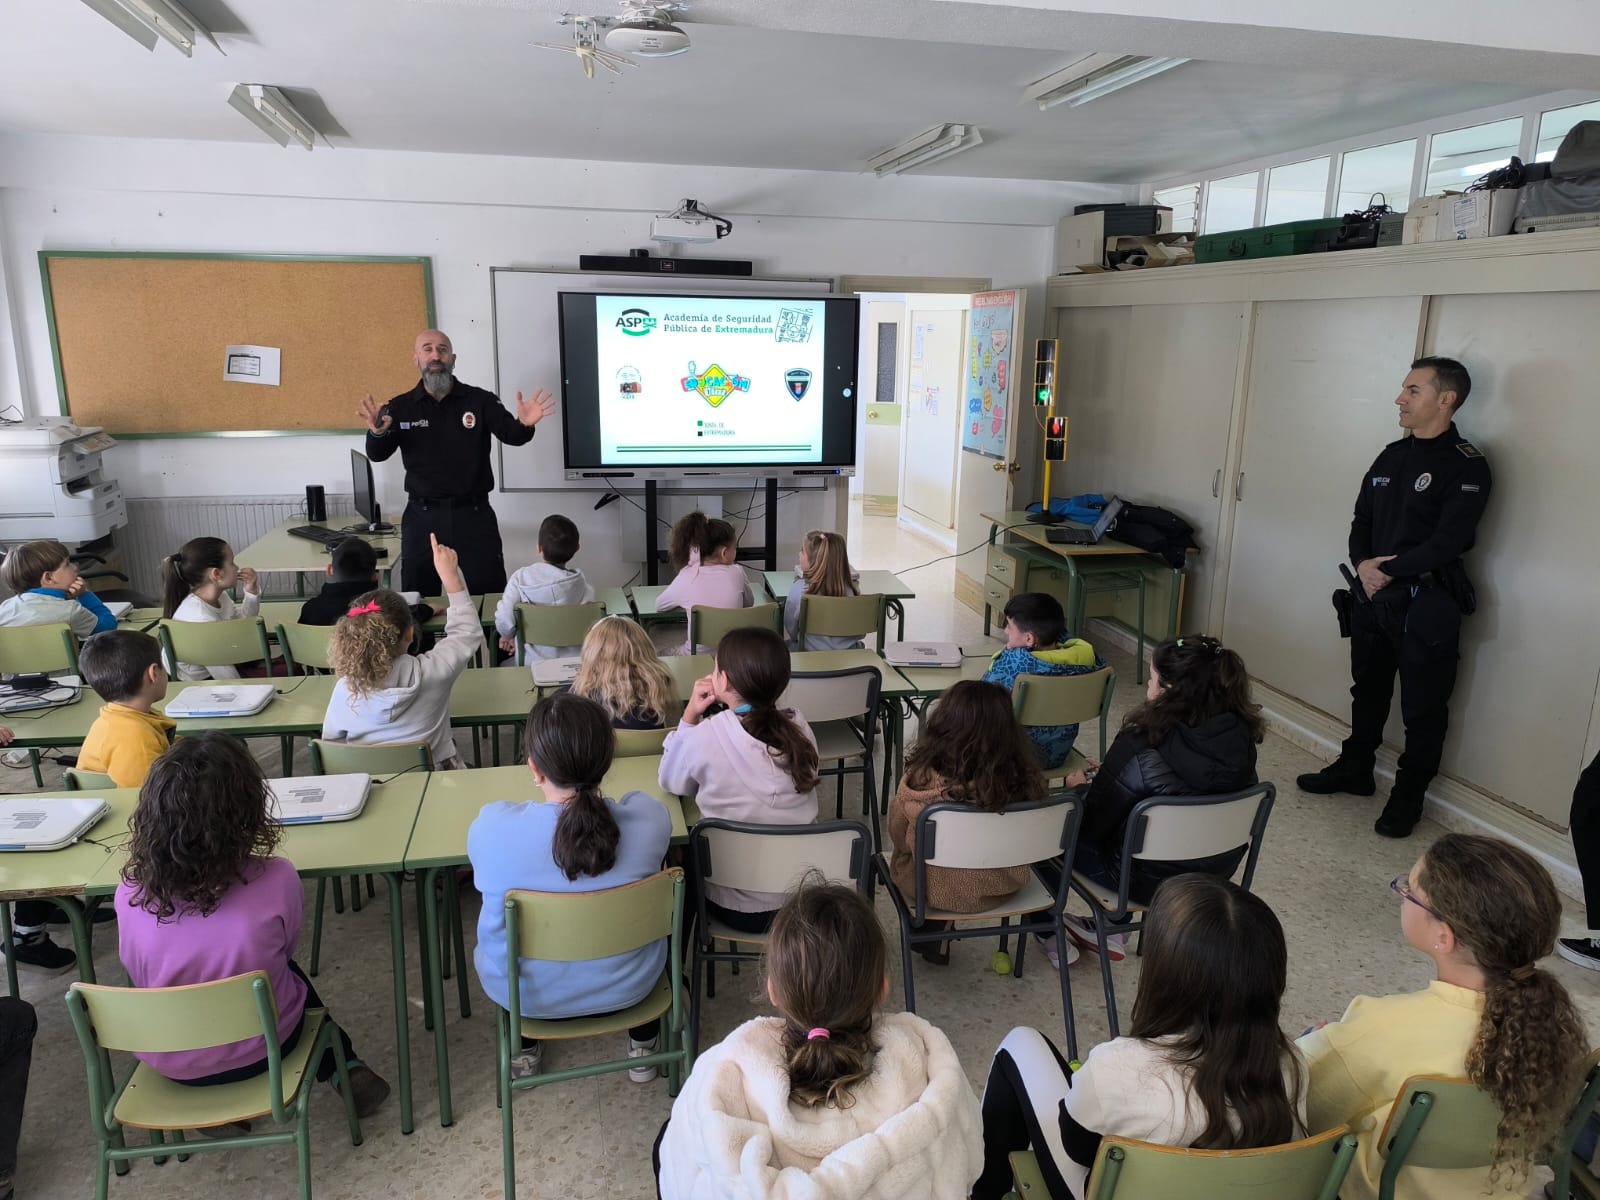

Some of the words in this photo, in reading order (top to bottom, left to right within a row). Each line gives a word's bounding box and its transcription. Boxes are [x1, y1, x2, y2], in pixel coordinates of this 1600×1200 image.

[712, 314, 723, 322] de
[663, 324, 698, 333] Pública
[700, 324, 712, 333] de
[715, 324, 774, 334] Extremadura
